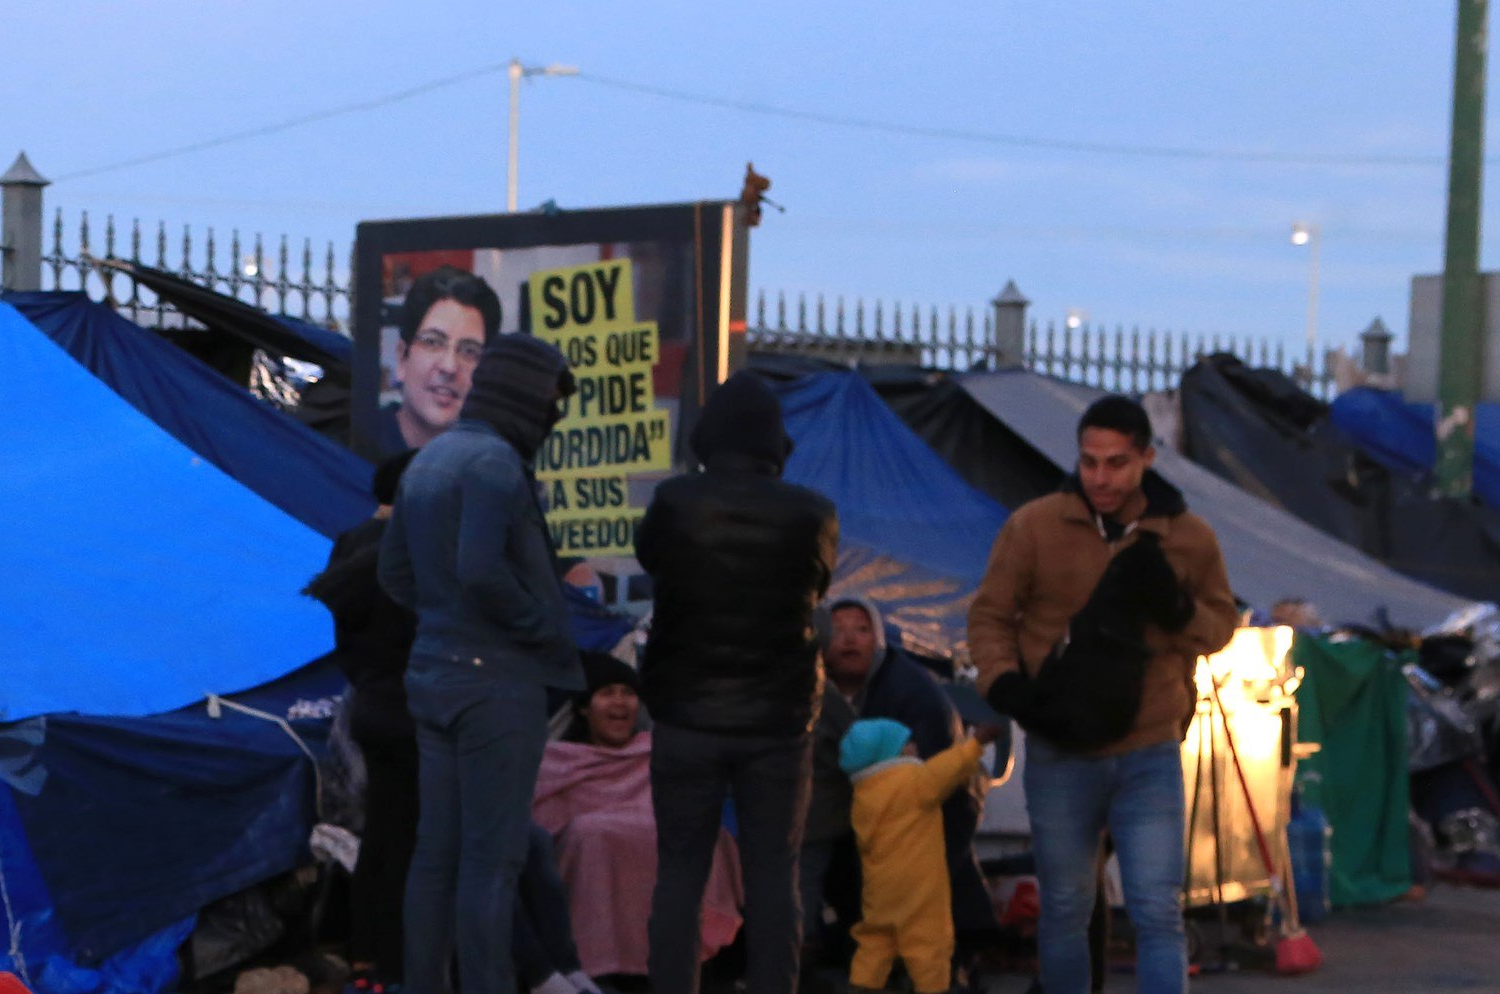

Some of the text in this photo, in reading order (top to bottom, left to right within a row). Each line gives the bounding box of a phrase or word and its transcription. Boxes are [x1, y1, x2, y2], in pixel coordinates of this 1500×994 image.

[542, 266, 621, 329] SOY
[556, 330, 653, 368] OS QUE
[579, 371, 647, 418] PIDE
[552, 476, 624, 510] A SUS
